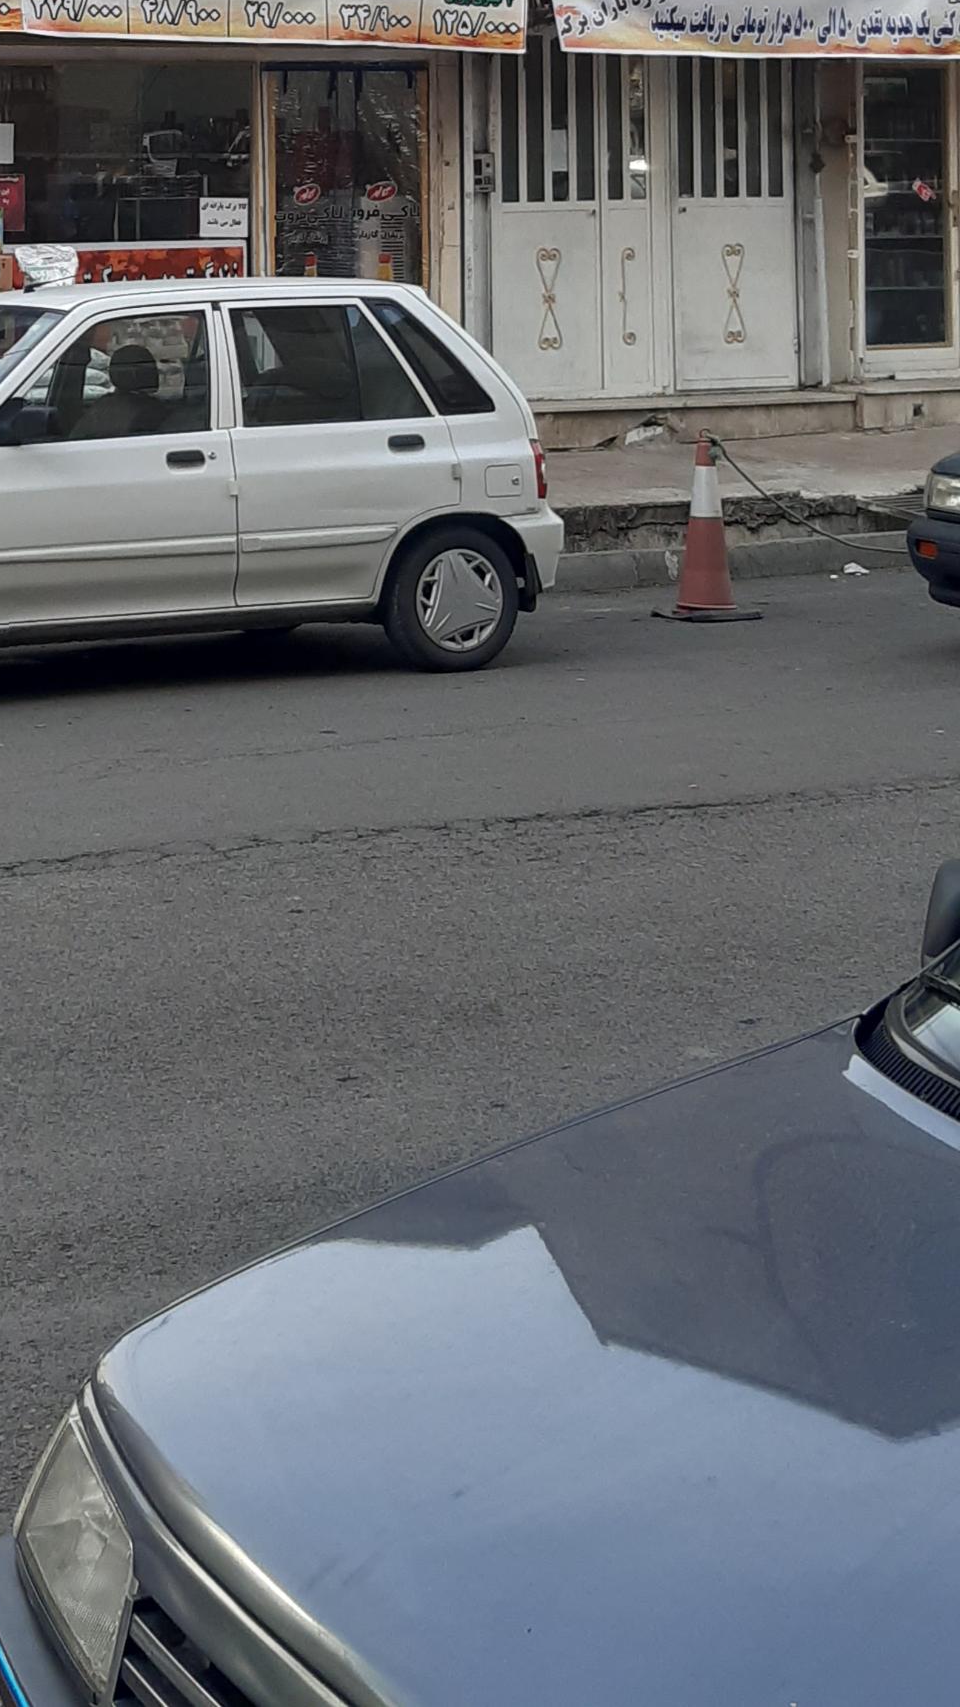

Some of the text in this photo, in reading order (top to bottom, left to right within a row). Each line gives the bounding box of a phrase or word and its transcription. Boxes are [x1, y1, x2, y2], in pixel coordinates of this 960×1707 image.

[244, 0, 316, 29] ۲۹/۰۰۰
[339, 4, 411, 31] ۳۴/۹۰۰
[433, 9, 521, 37] ۱۲۵/۰۰۰
[651, 5, 687, 39] میکنید
[690, 3, 729, 43] دریافت
[731, 5, 768, 44] تومانی
[768, 6, 792, 44] هزار
[818, 6, 837, 44] الی
[857, 8, 883, 44] نقدی
[886, 15, 913, 43] هدیه
